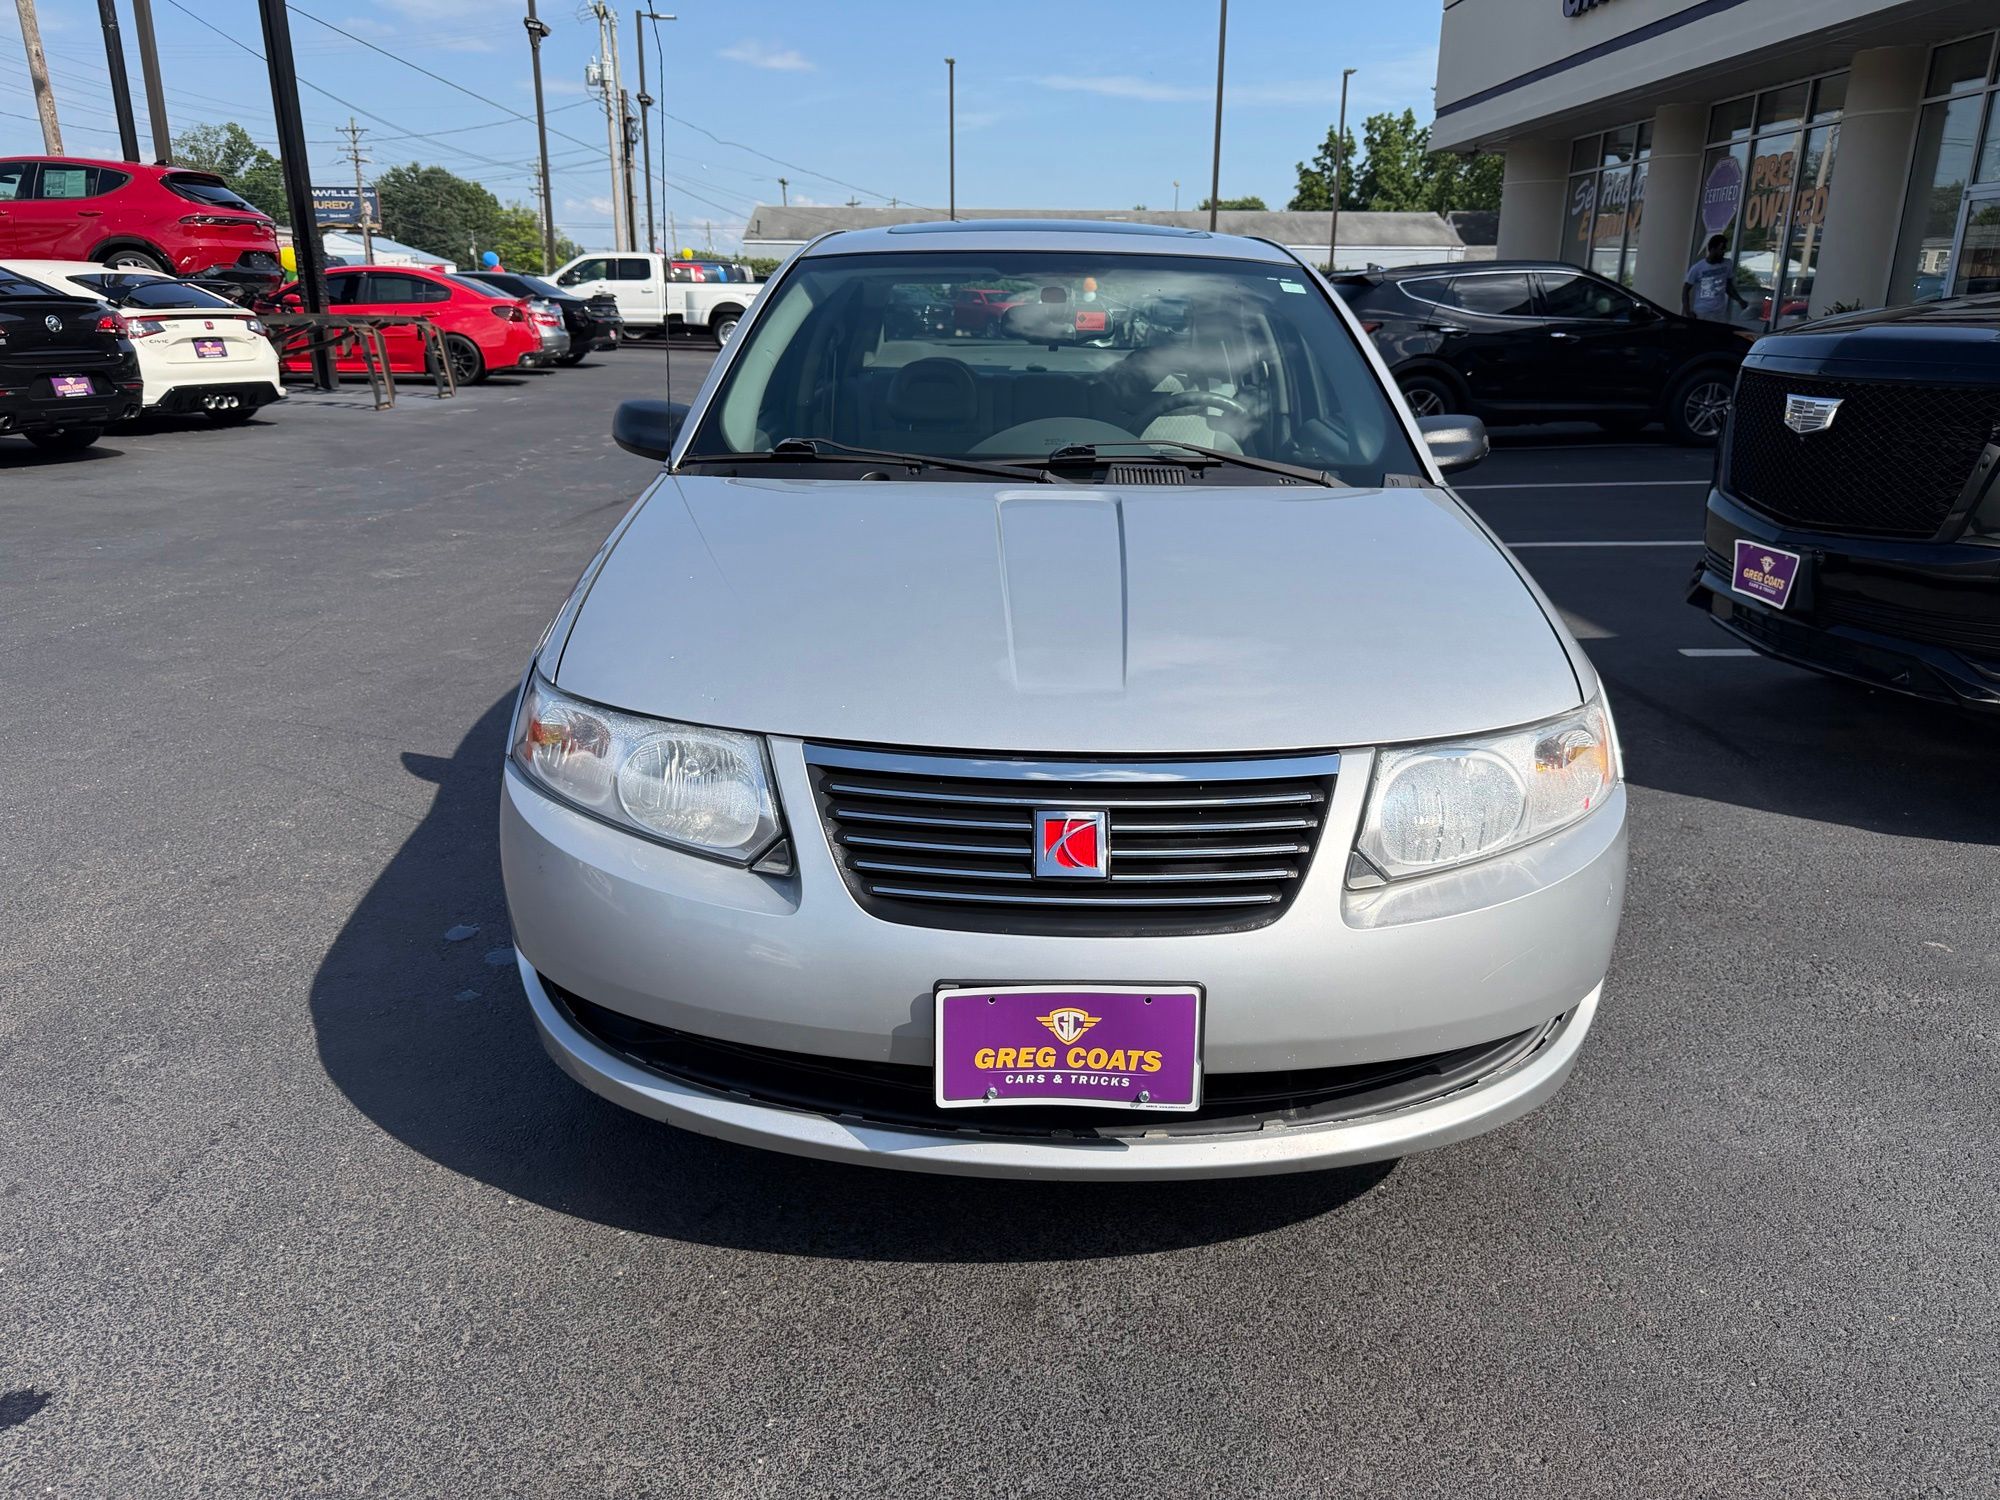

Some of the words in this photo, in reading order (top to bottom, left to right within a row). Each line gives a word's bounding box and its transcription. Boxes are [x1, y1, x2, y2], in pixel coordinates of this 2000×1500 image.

[1751, 152, 1793, 190] PRE
[1704, 184, 1739, 204] CERTIFIED
[1744, 568, 1763, 582] GREG
[1764, 574, 1785, 590] COATS
[974, 1046, 1057, 1070] GREG
[1066, 1047, 1163, 1073] COATS
[1005, 1074, 1046, 1085] CARS
[1053, 1075, 1063, 1084] &
[1070, 1075, 1131, 1087] TRUCKS
